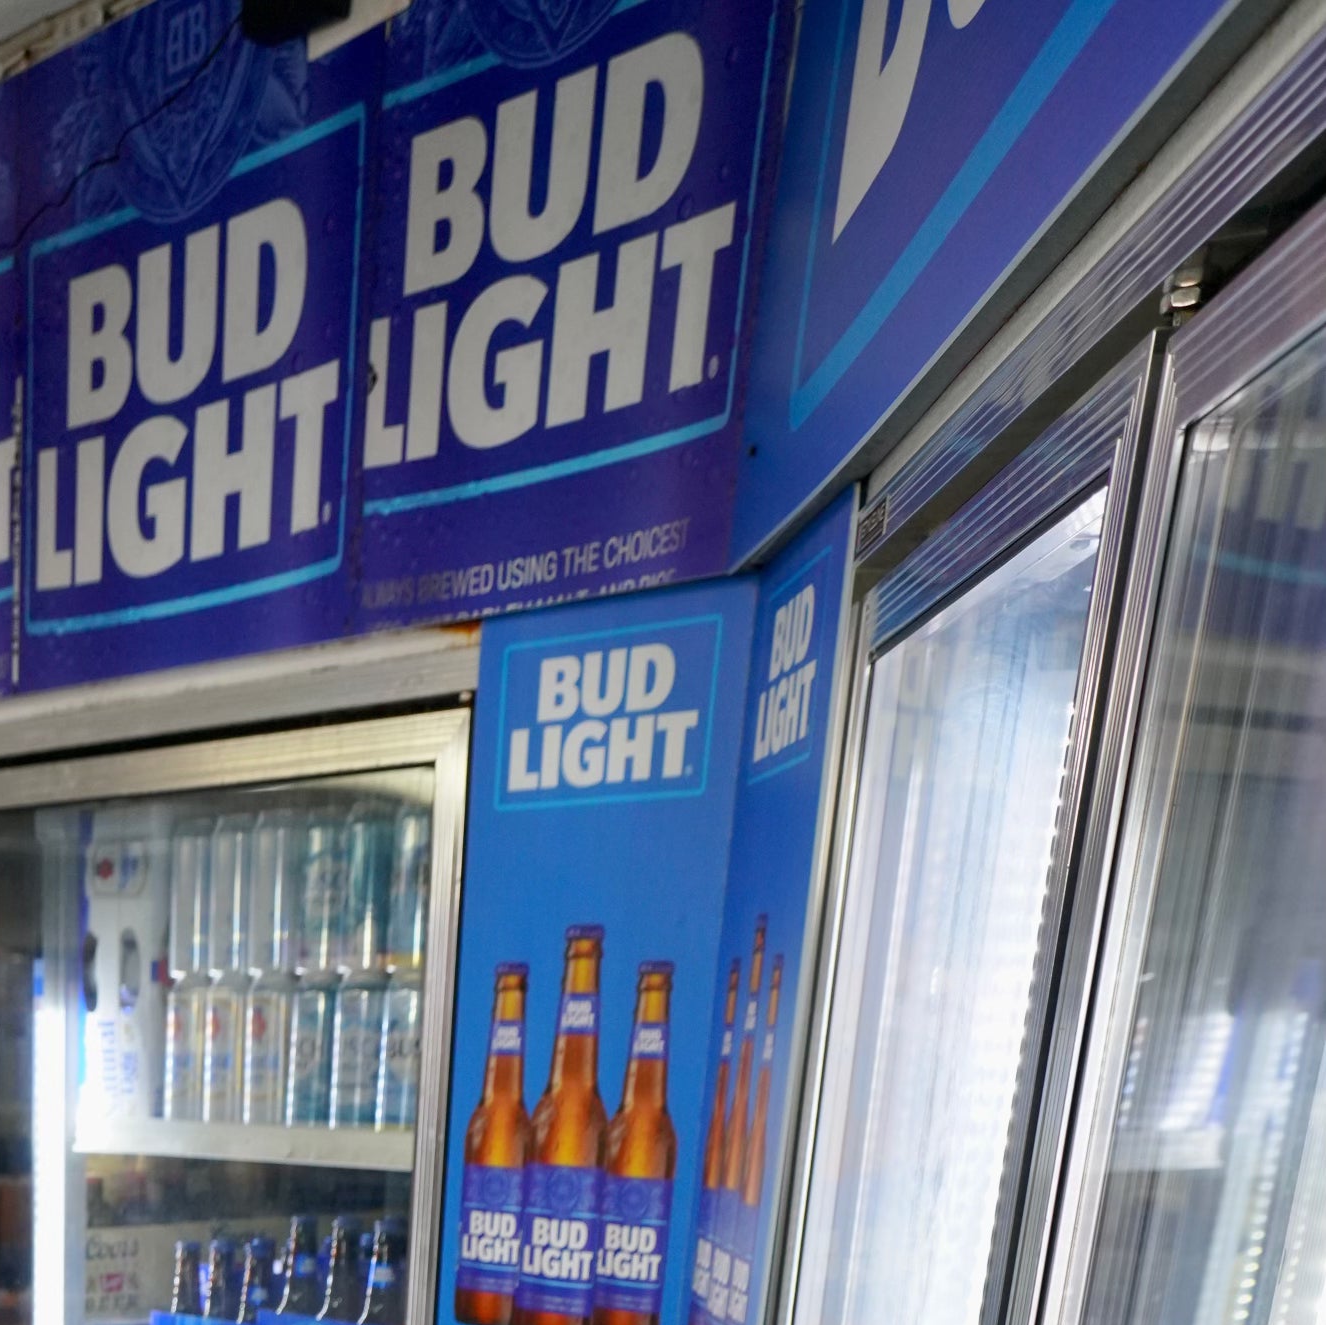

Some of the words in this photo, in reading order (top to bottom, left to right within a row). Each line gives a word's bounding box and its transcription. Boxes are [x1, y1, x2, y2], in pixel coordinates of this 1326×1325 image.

[403, 31, 705, 297] BUD
[67, 197, 308, 430] BUD
[363, 201, 737, 470] LIGHT
[35, 359, 340, 592] LIGHT
[496, 550, 560, 591] USING
[561, 542, 601, 579] THE
[769, 583, 816, 685] BUD
[537, 643, 675, 723] BUD
[753, 659, 818, 765] LIGHT
[507, 709, 699, 793] LIGHT
[462, 1234, 520, 1265] LIGHT
[469, 1209, 517, 1239] BUD
[522, 1245, 594, 1282] LIGHT
[532, 1216, 588, 1250] BUD
[605, 1223, 657, 1253] BUD
[596, 1248, 662, 1281] LIGHT
